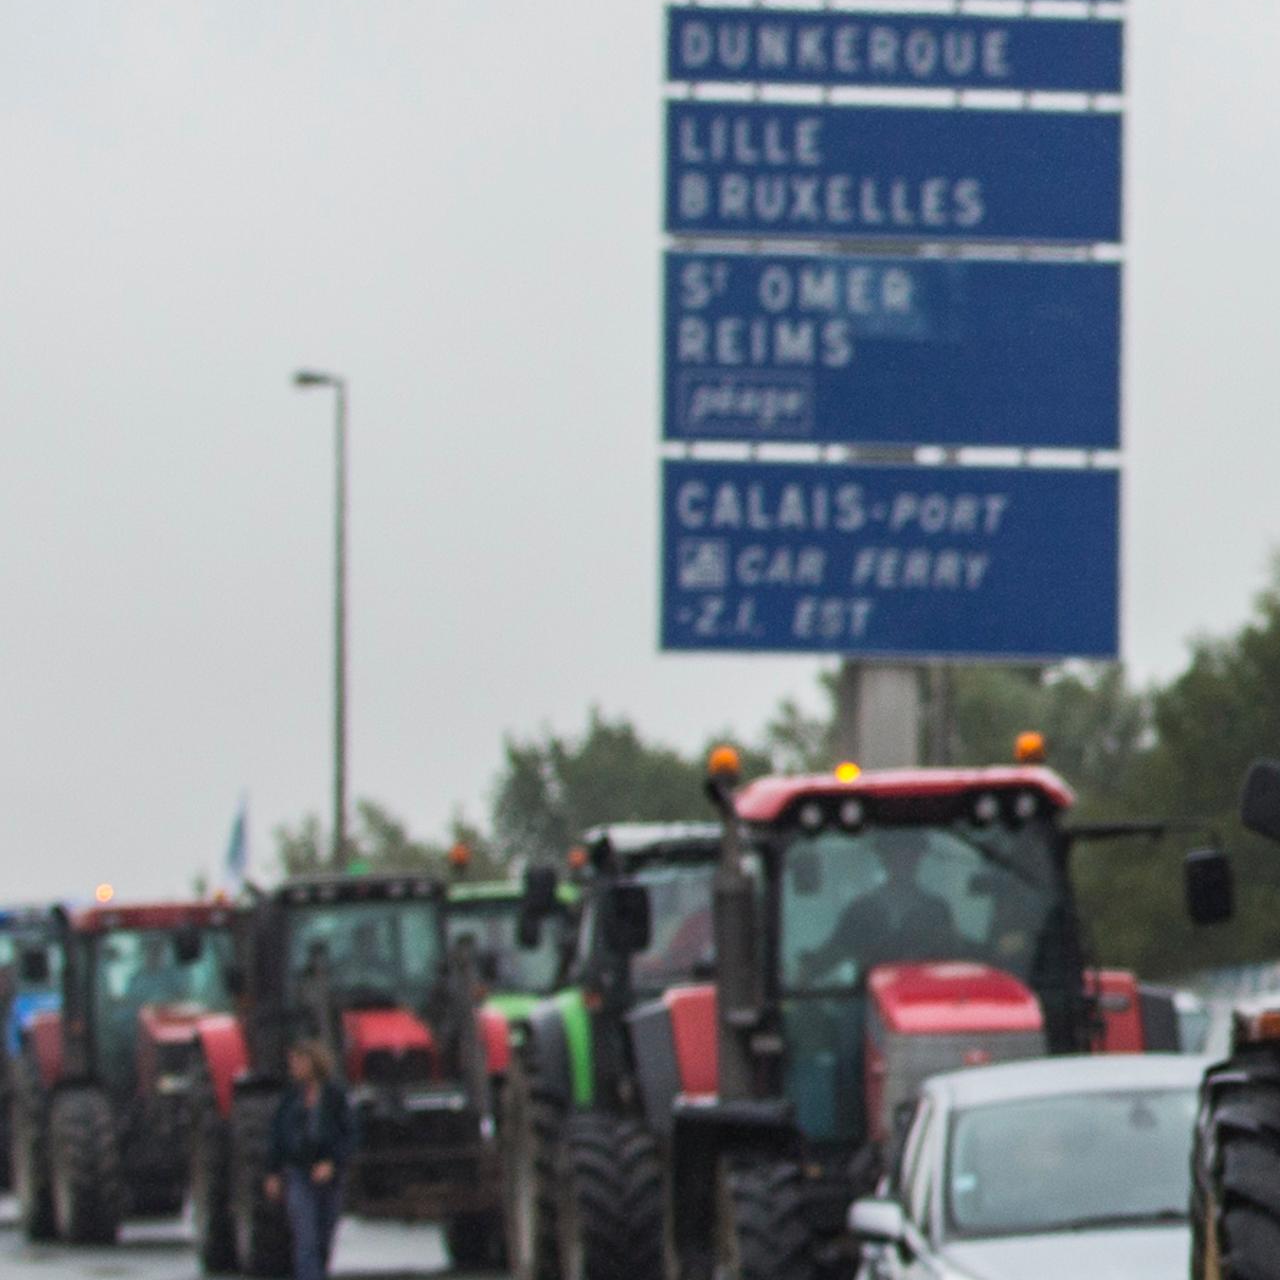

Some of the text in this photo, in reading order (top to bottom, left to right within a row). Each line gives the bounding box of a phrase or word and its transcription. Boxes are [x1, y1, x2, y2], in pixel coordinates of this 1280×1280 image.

[682, 21, 1011, 77] DUNKERQUE
[679, 118, 823, 166] LILLE
[679, 172, 985, 225] BRUXELLES
[759, 265, 913, 314] OMER
[677, 317, 854, 368] REIMS
[735, 544, 991, 592] CAR FERRY
[793, 595, 875, 638] EST
